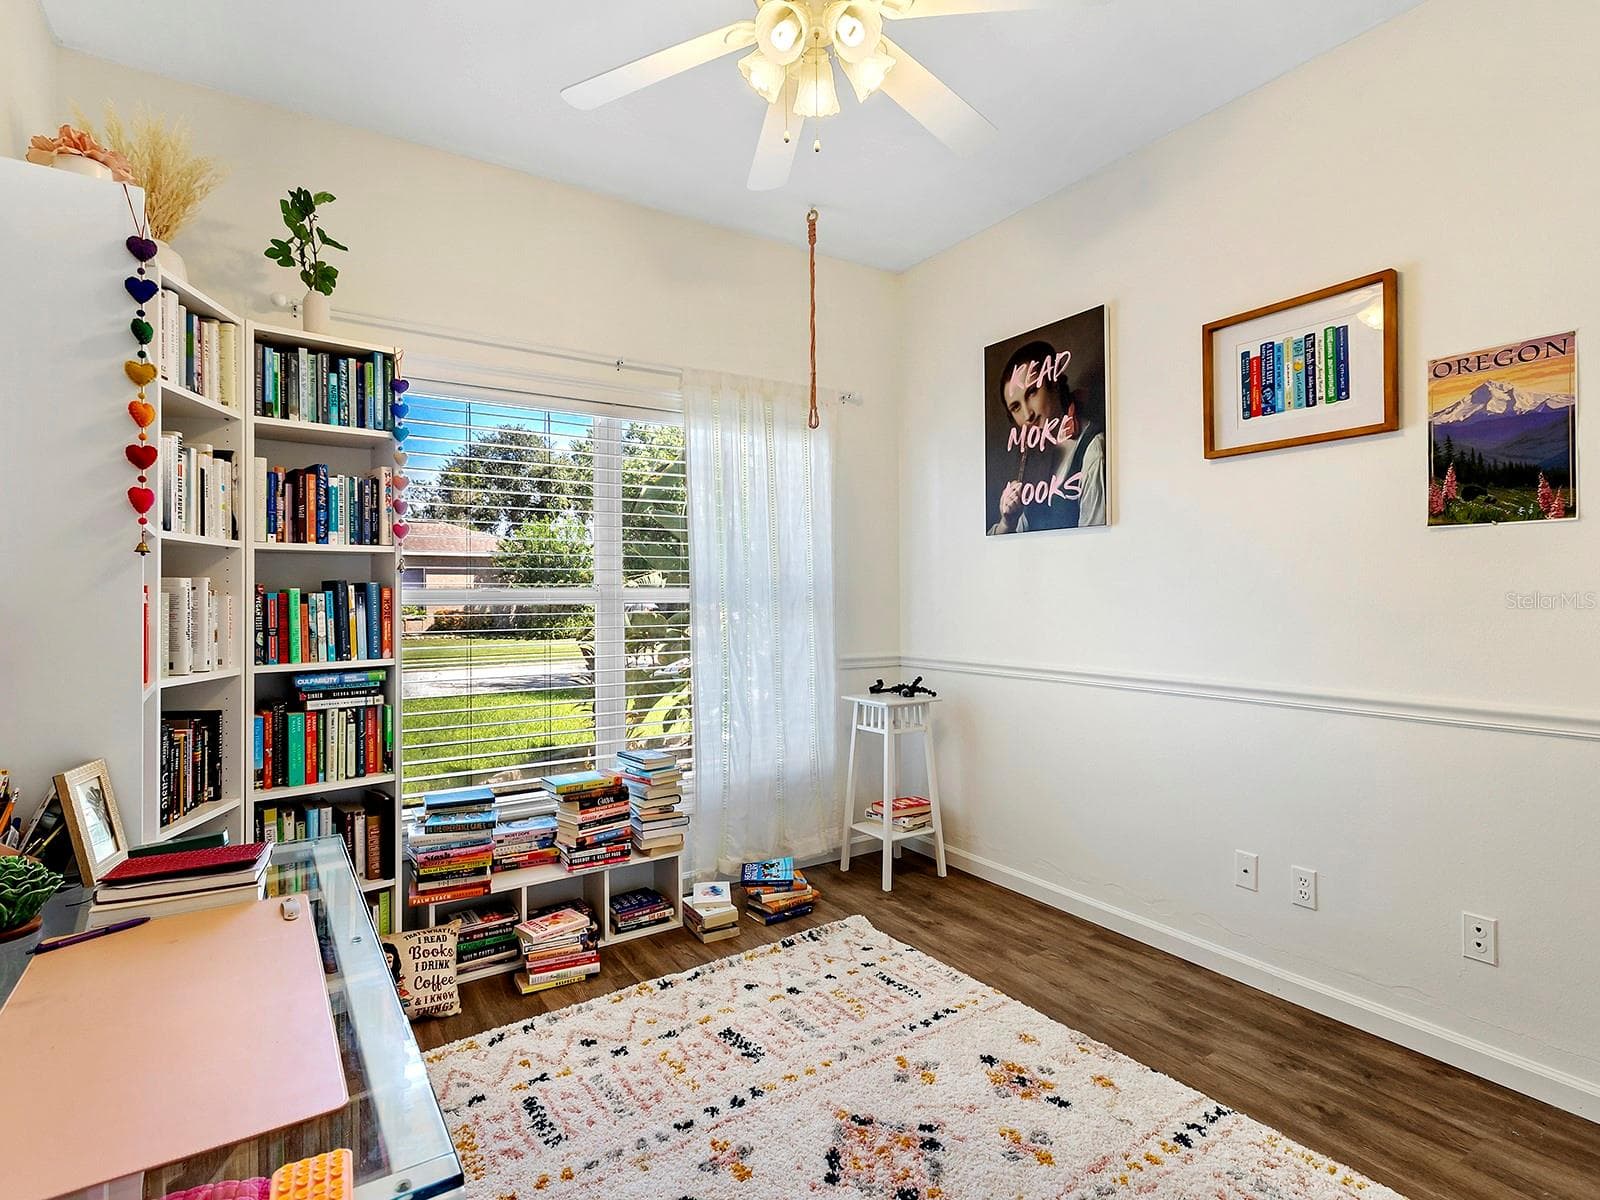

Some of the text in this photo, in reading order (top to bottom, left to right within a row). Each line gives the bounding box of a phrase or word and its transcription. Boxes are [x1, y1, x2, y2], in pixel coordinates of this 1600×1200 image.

[1432, 338, 1568, 378] OREGON
[1008, 350, 1071, 397] READ
[1007, 414, 1074, 453] MORE
[1002, 472, 1085, 514] BOOKS
[297, 676, 337, 685] CULPABILITY
[413, 896, 429, 904] PALM
[431, 894, 451, 902] BEACH
[424, 935, 448, 943] READ
[409, 944, 454, 960] Books
[415, 960, 450, 972] I DRINK
[414, 975, 455, 992] Coffee
[414, 991, 455, 1006] & I KNOW
[414, 1002, 455, 1016] THINGS
